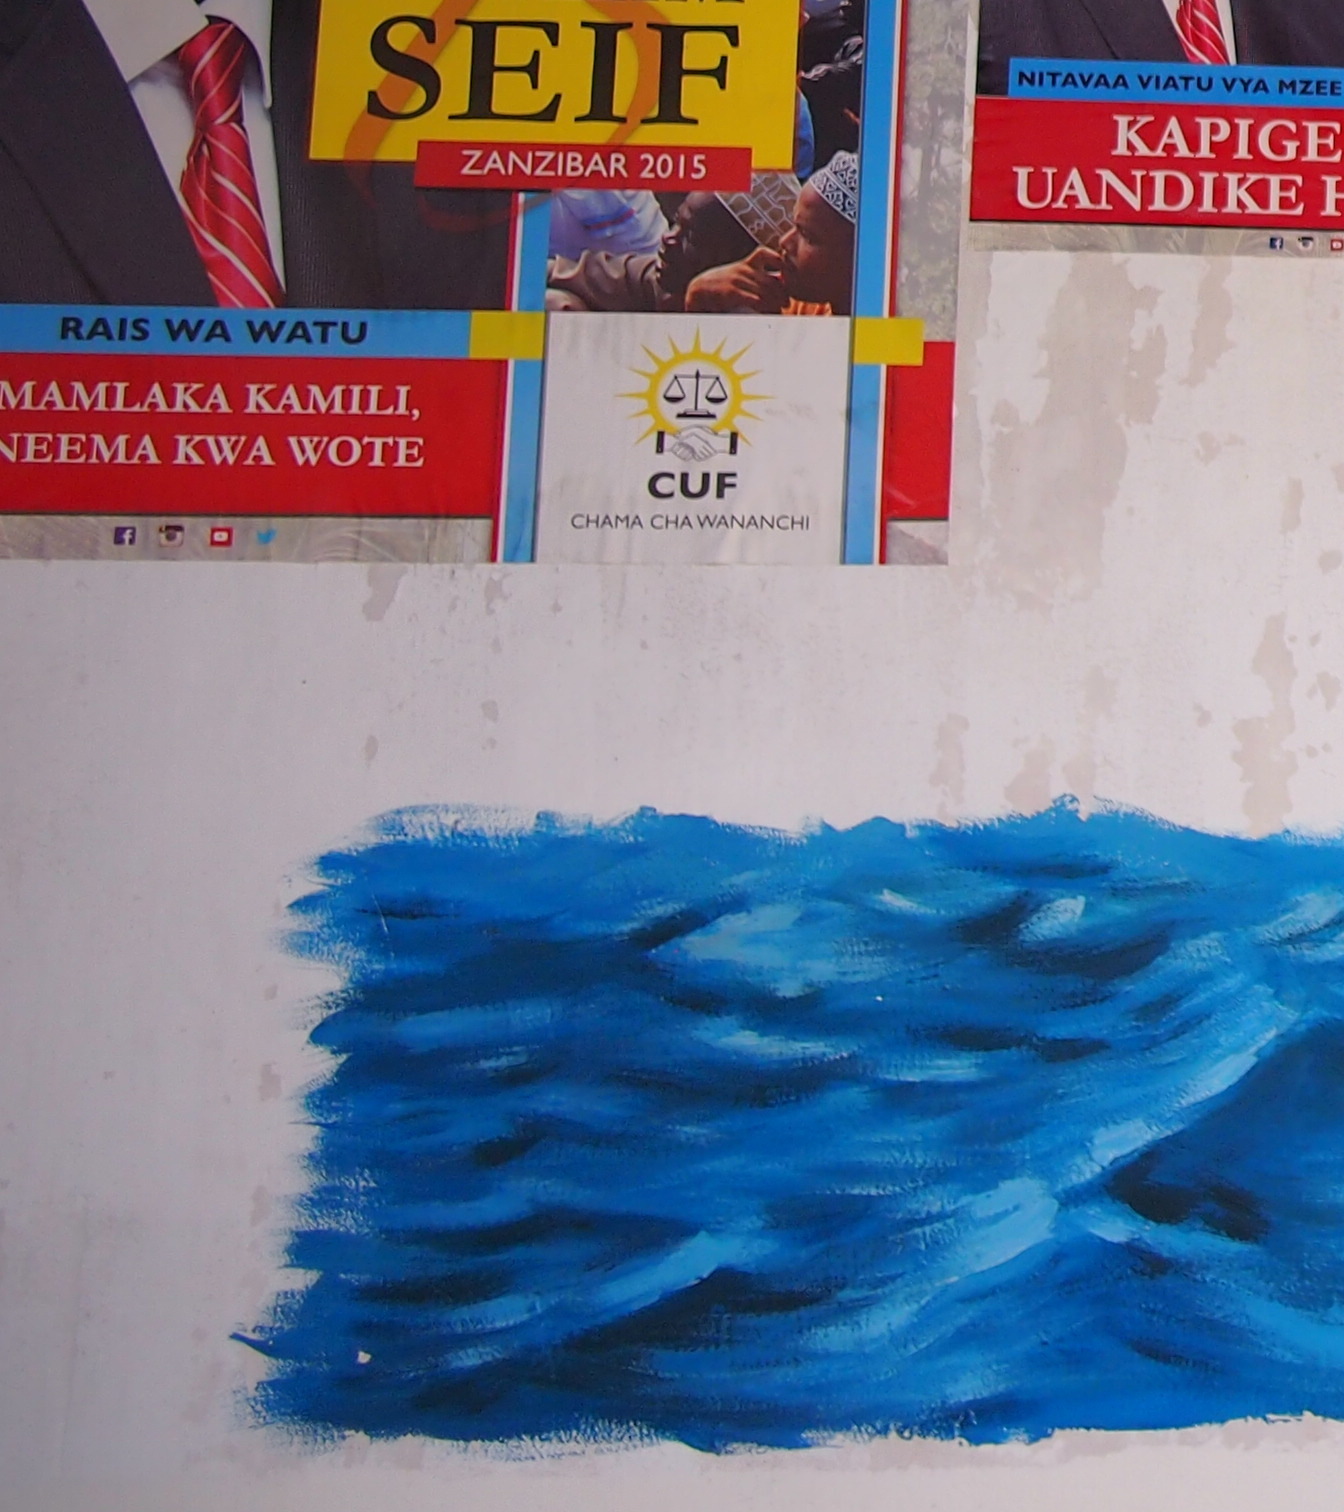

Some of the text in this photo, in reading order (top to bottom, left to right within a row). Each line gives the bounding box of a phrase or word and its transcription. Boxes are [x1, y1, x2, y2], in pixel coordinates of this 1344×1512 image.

[367, 15, 740, 126] SEIF
[1017, 70, 1129, 90] NITAVAA
[1137, 73, 1214, 93] VIATU
[1221, 76, 1268, 95] VYA
[1277, 78, 1342, 97] MZEE
[1111, 115, 1343, 163] KAPIGE
[460, 150, 707, 180] ZANZIBAR 2015
[1012, 166, 1304, 215] UANDIKE
[60, 317, 369, 345] RAIS WA WATU
[0, 380, 421, 421] MAMLAKA KAMILI,
[172, 434, 276, 466] KWA
[287, 436, 425, 468] WOTE
[647, 472, 738, 499] CUF
[571, 514, 810, 531] CHAMA CHA WANANCHI
